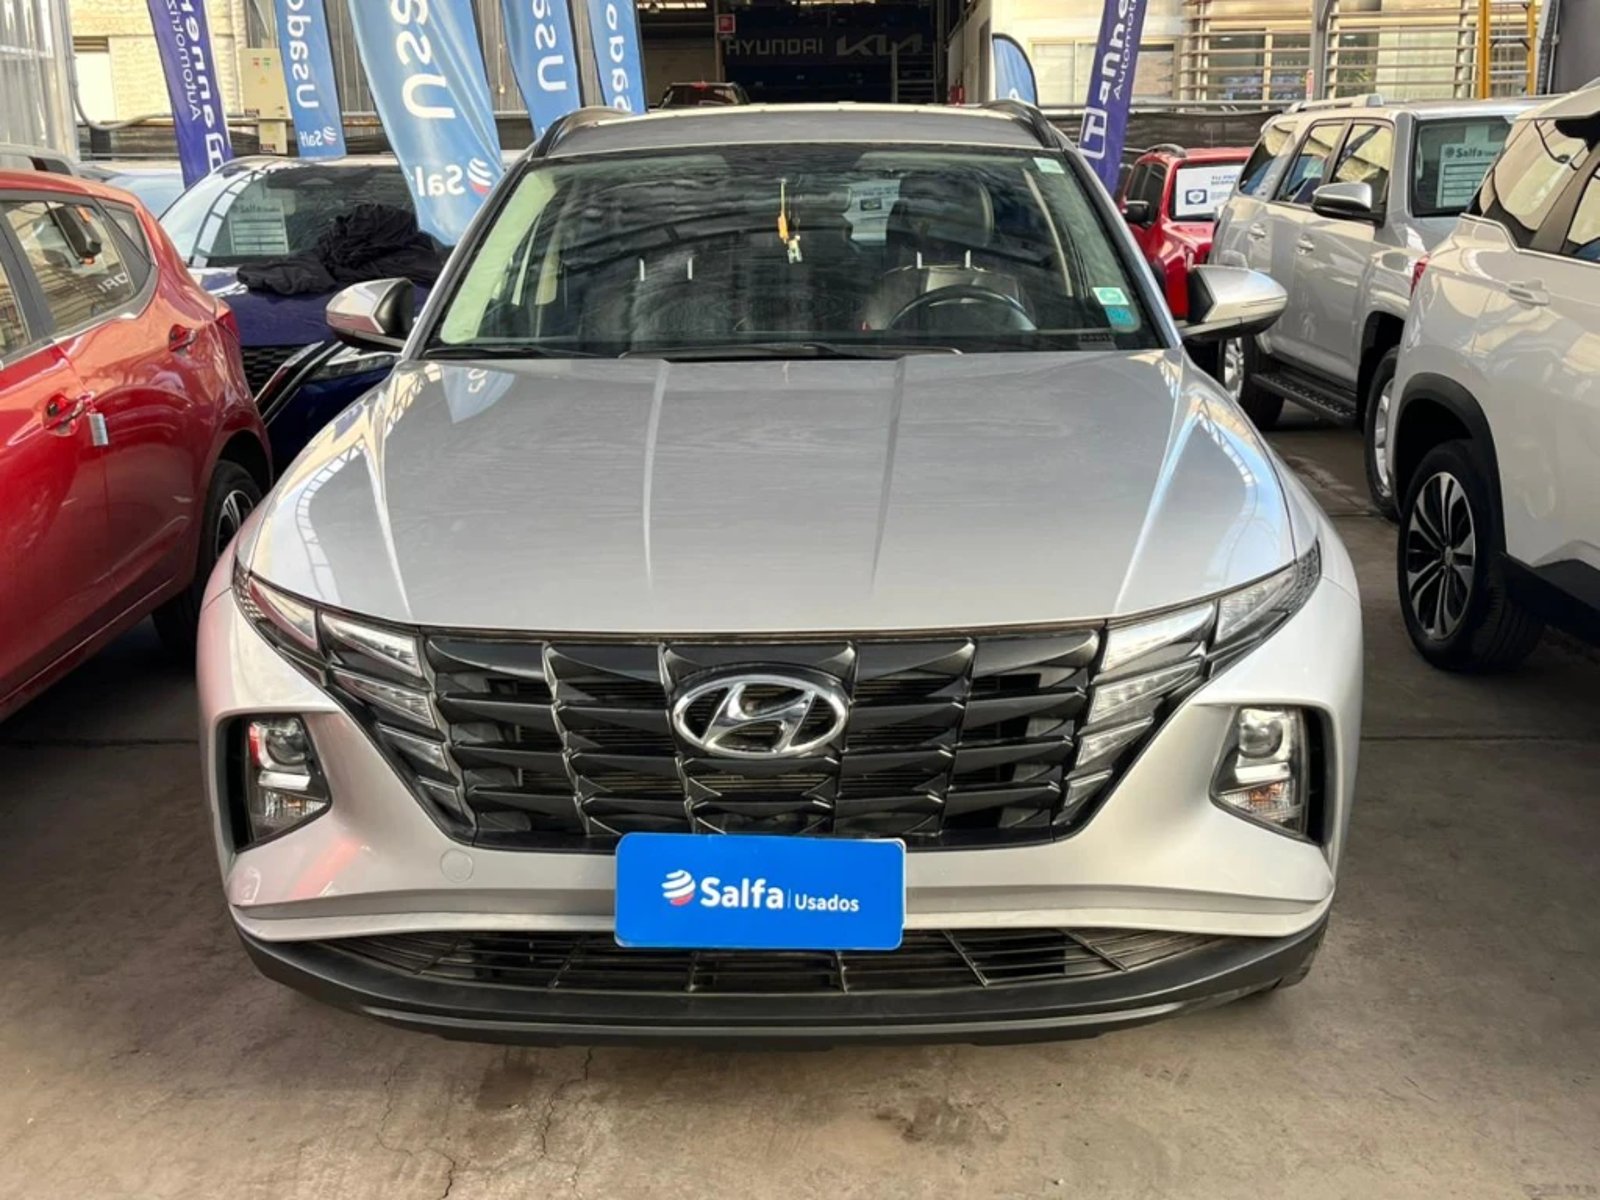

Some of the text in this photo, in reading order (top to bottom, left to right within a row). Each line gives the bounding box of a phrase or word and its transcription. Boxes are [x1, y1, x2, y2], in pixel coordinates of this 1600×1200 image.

[726, 37, 822, 56] HYUNDAI
[701, 877, 860, 912] Salfa Usados
